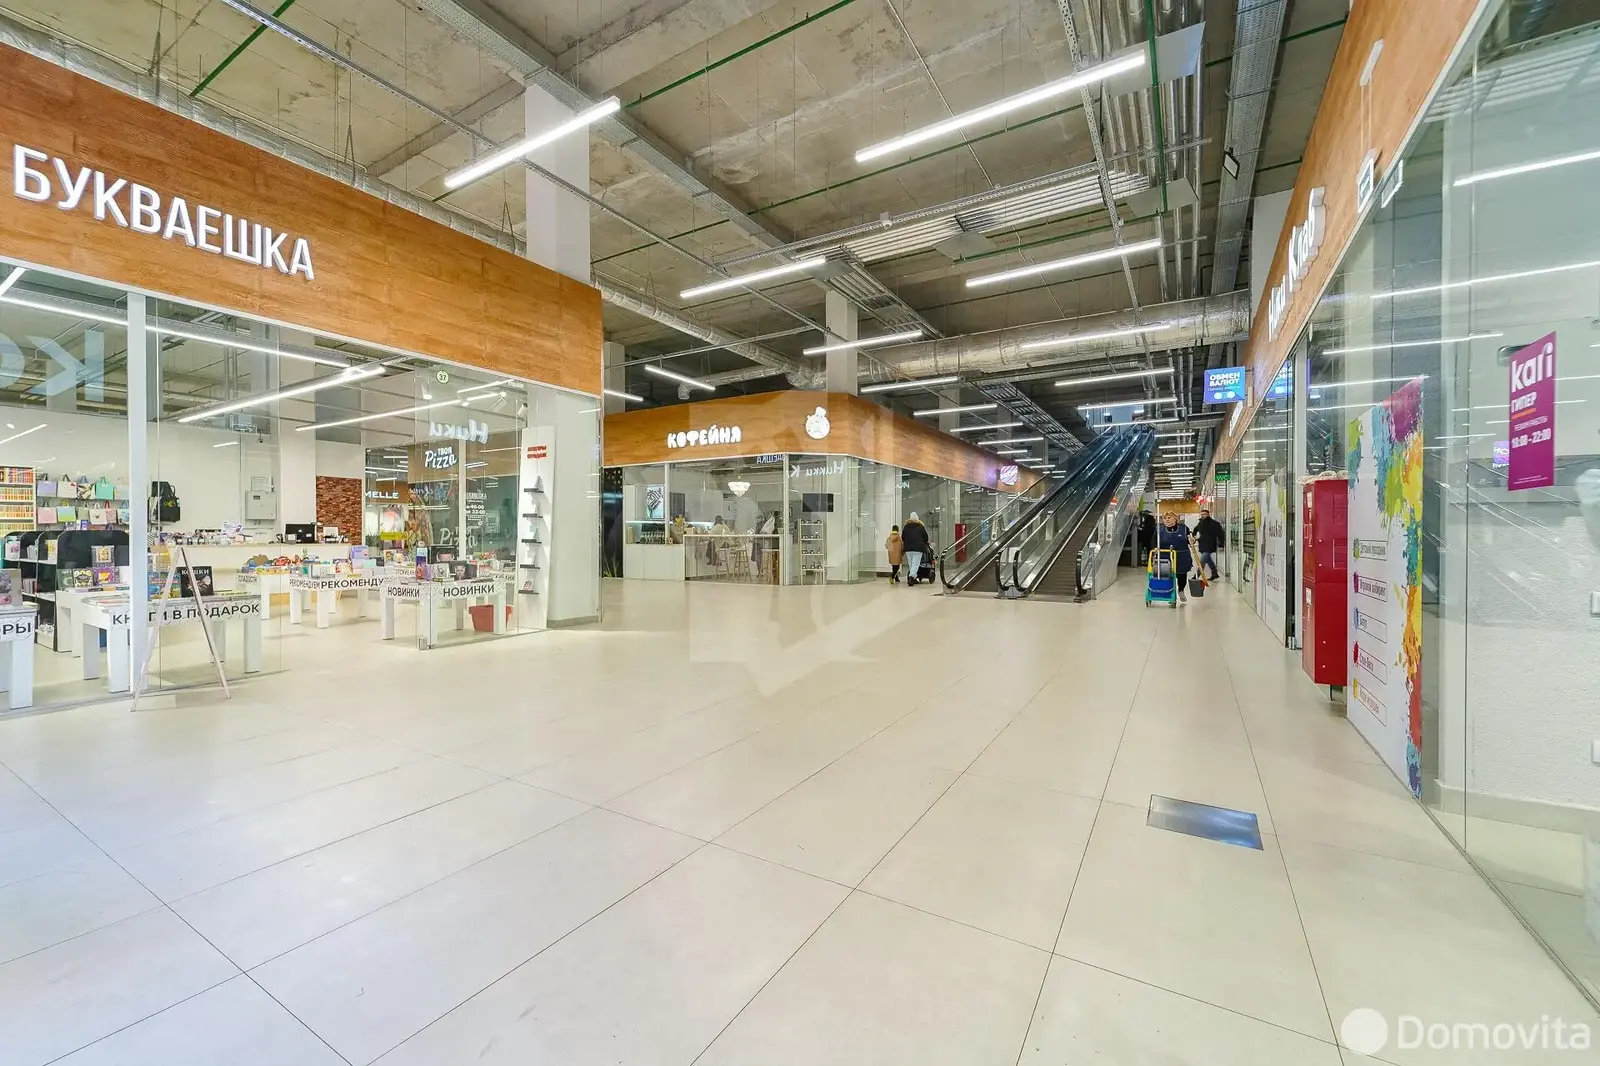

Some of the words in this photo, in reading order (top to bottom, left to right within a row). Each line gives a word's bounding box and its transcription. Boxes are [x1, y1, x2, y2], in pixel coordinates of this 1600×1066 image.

[13, 144, 314, 280] БУКВАЕШКА
[1511, 342, 1553, 393] kari
[1209, 372, 1240, 381] ОБМЕН
[667, 424, 742, 449] КОФЕЙНЯ
[424, 450, 457, 468] Pizza
[321, 578, 384, 589] РЕКОМЕНДУ
[388, 587, 420, 597] НОВИНКИ
[443, 584, 495, 597] НОВИНКИ
[173, 610, 182, 620] В
[0, 623, 31, 635] РЫ
